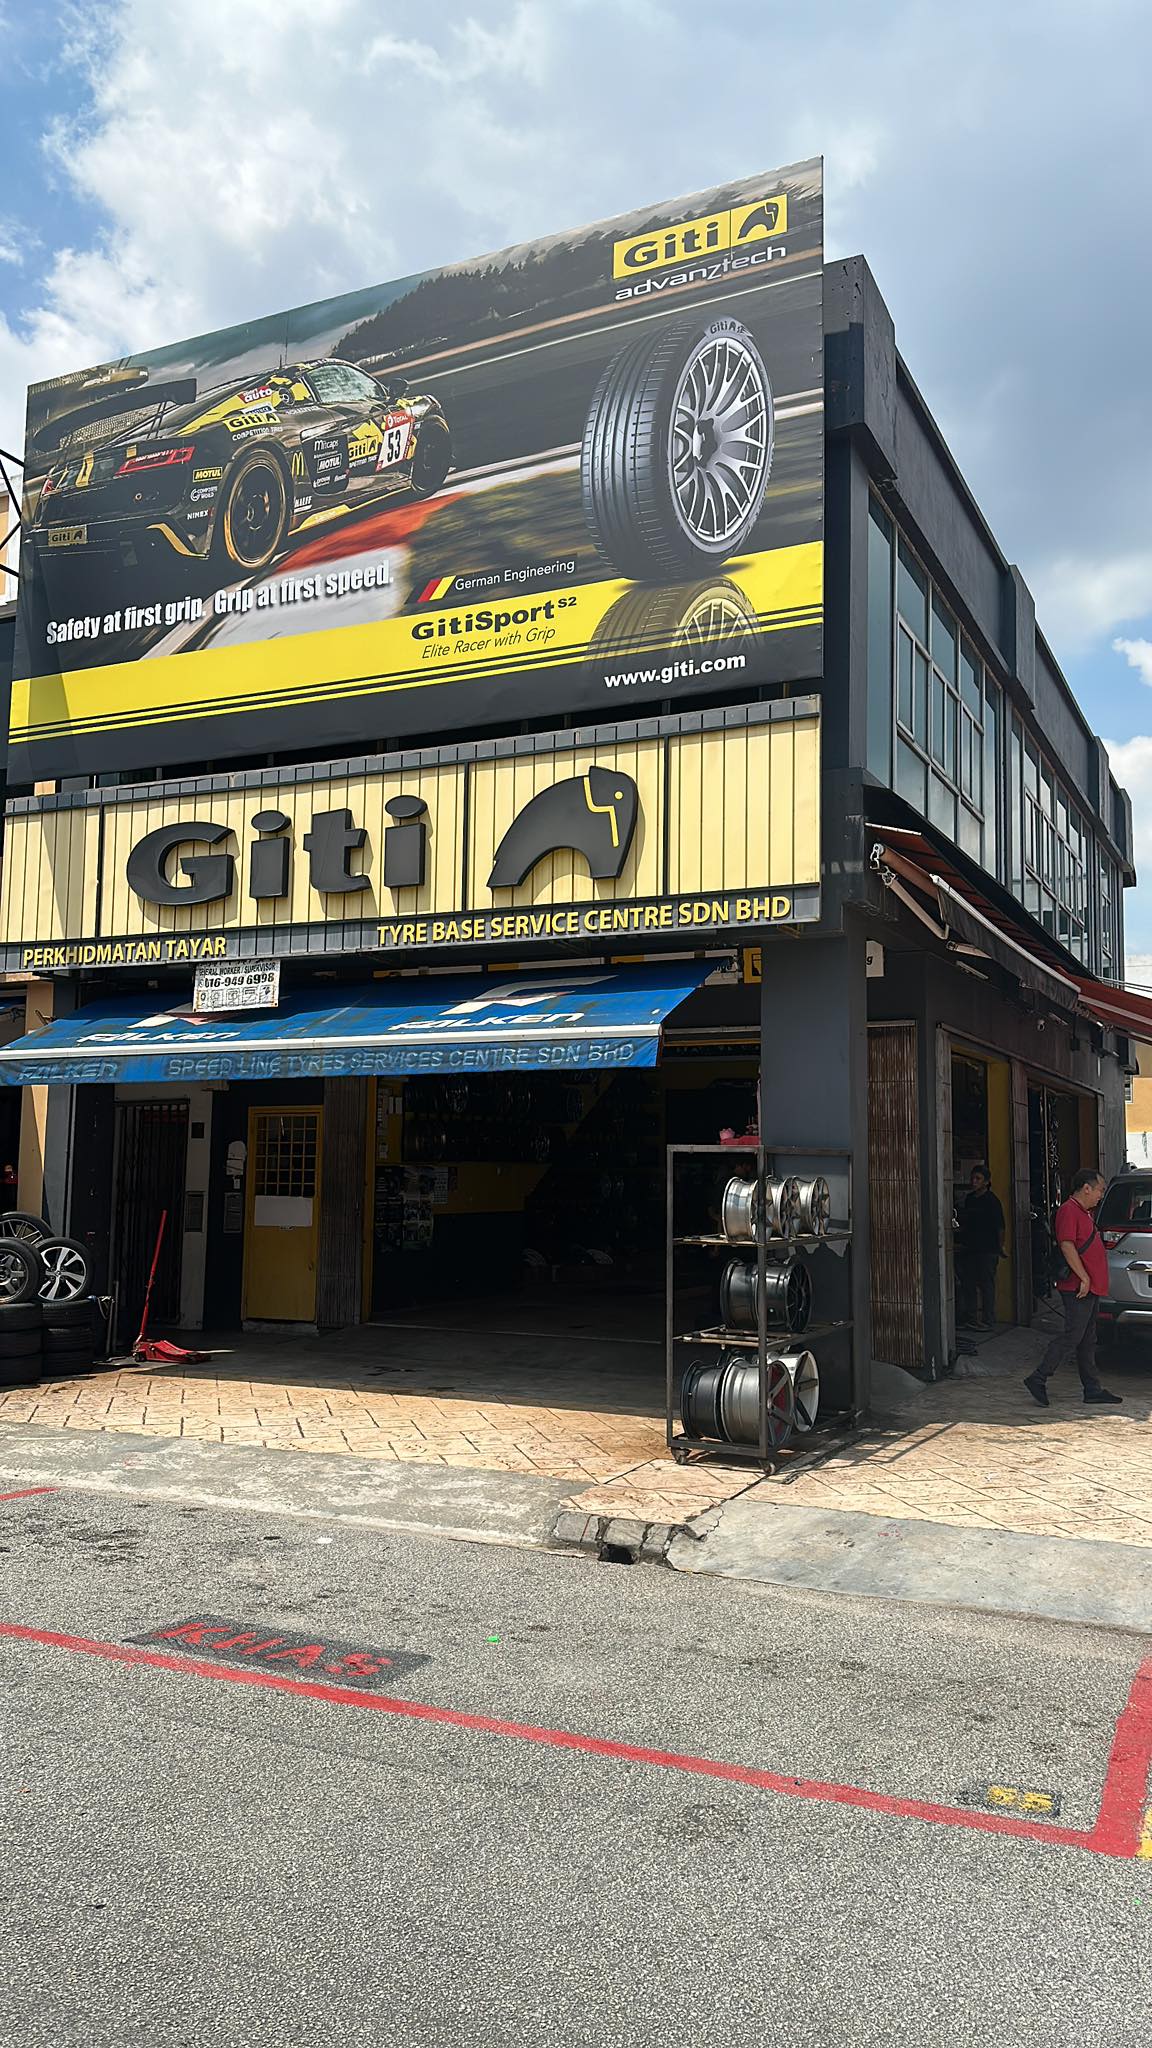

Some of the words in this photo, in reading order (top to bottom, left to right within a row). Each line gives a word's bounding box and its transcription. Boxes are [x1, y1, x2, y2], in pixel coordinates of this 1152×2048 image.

[624, 221, 719, 267] Giti
[615, 246, 786, 301] advanztech
[710, 320, 728, 334] Giti
[244, 386, 273, 403] auto
[229, 413, 263, 428] Giti
[387, 429, 402, 462] 53
[195, 468, 221, 479] MOTUL
[318, 456, 340, 471] MOTUL
[51, 531, 71, 542] Giti
[455, 573, 501, 591] German
[504, 560, 575, 582] Engineering
[46, 616, 101, 645] Safety
[103, 610, 122, 635] at
[124, 603, 162, 630] first
[165, 596, 207, 626] grip.
[214, 587, 253, 614] Grip
[257, 583, 278, 607] at
[281, 574, 324, 603] first
[326, 559, 395, 595] speed.
[411, 599, 555, 641] GitiSport
[421, 644, 451, 659] Elite
[453, 637, 491, 655] Racer
[494, 629, 522, 647] with
[525, 626, 556, 644] Grip
[604, 654, 746, 688] www.giti.com
[126, 794, 427, 906] Giti
[377, 922, 428, 946] TYRE
[432, 918, 486, 942] BASE
[490, 911, 580, 938] SERVICE
[583, 904, 673, 931] CENTRE
[678, 900, 729, 925] SDN
[736, 895, 791, 921] BHD
[23, 940, 161, 968] PERKHIDMATAN
[165, 936, 227, 959] TAYAR
[204, 975, 245, 988] 016-949
[246, 972, 275, 985] 6998
[168, 1057, 232, 1076] SPEED
[240, 1055, 281, 1075] LINE
[288, 1052, 346, 1073] TYRES
[350, 1050, 442, 1071] SERVICES
[449, 1047, 529, 1066] CENTRE
[538, 1044, 581, 1064] SDN
[587, 1042, 635, 1062] BHD
[157, 1622, 391, 1676] KHAS
